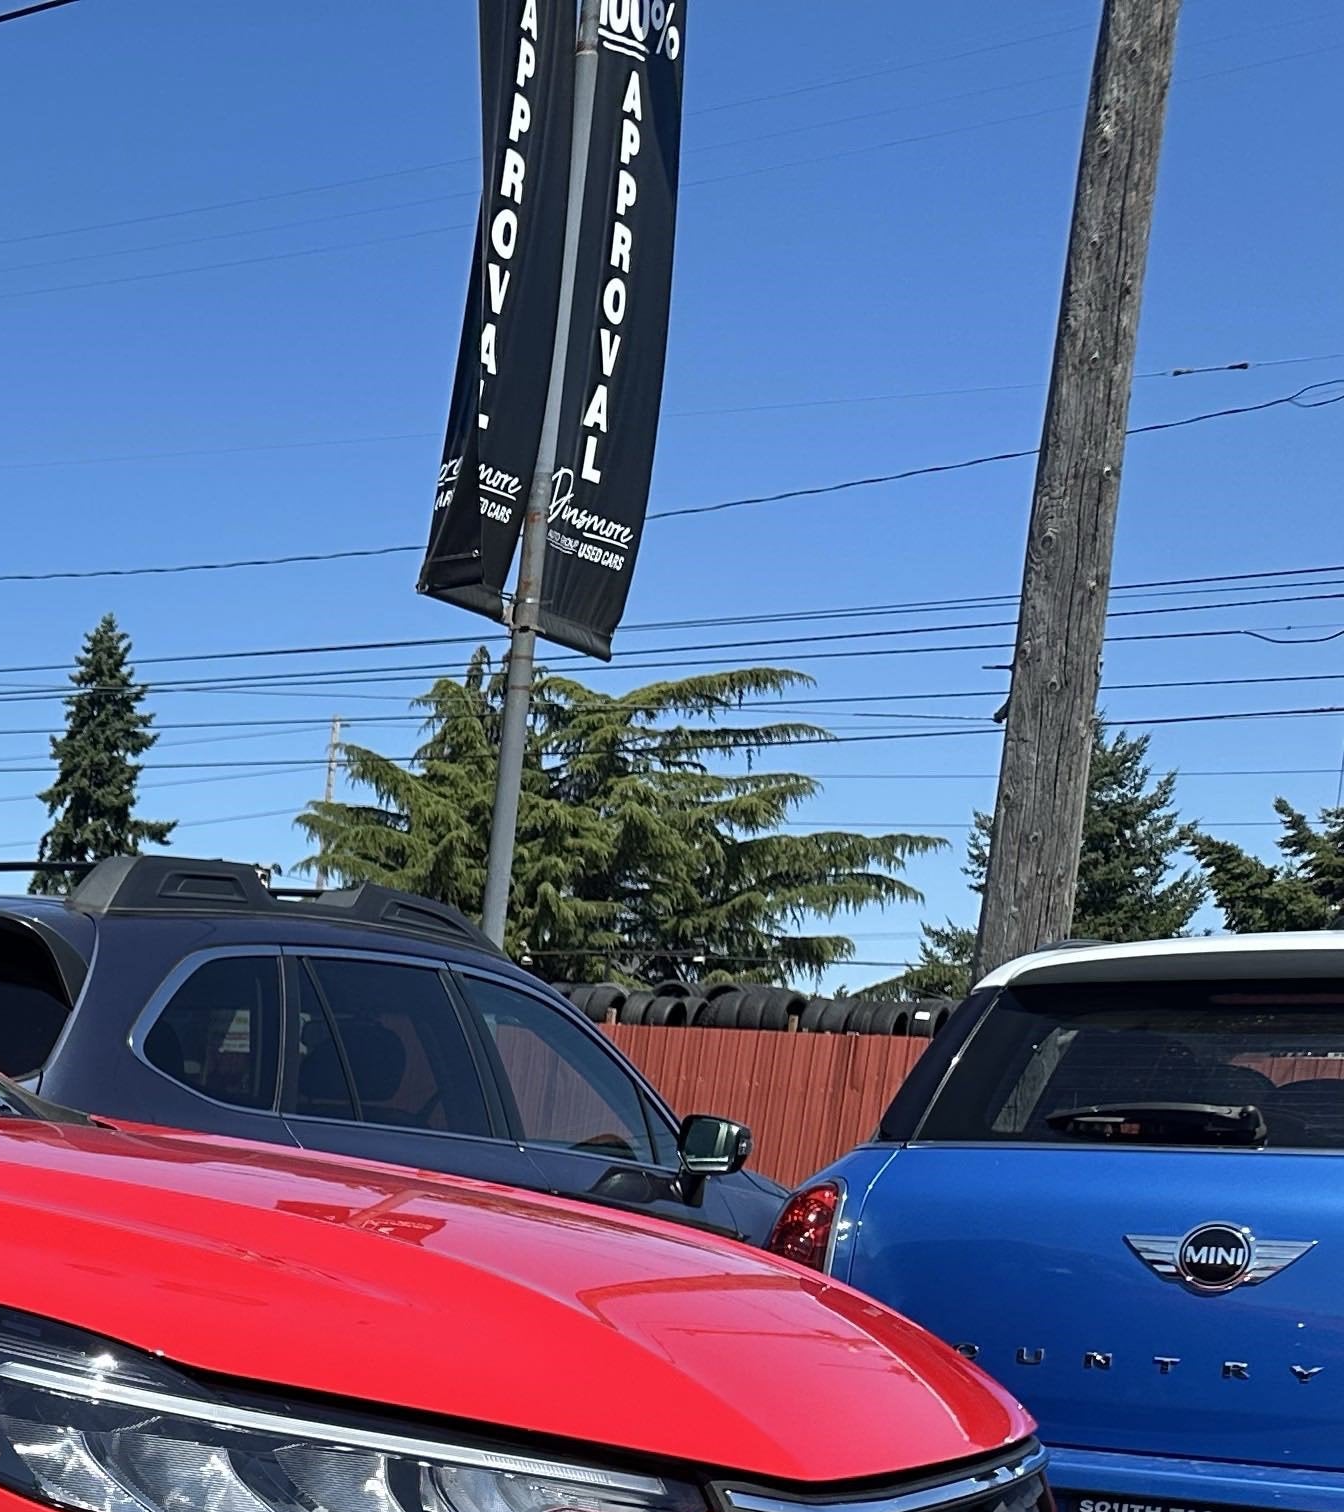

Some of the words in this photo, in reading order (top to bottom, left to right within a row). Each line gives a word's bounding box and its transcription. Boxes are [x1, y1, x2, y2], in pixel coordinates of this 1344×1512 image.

[581, 70, 641, 485] APPROVAL
[547, 466, 635, 544] Dinsmore
[577, 542, 603, 563] USED
[601, 550, 625, 571] CARS
[1184, 1245, 1244, 1266] MINI
[953, 1341, 1325, 1385] OUNTRY
